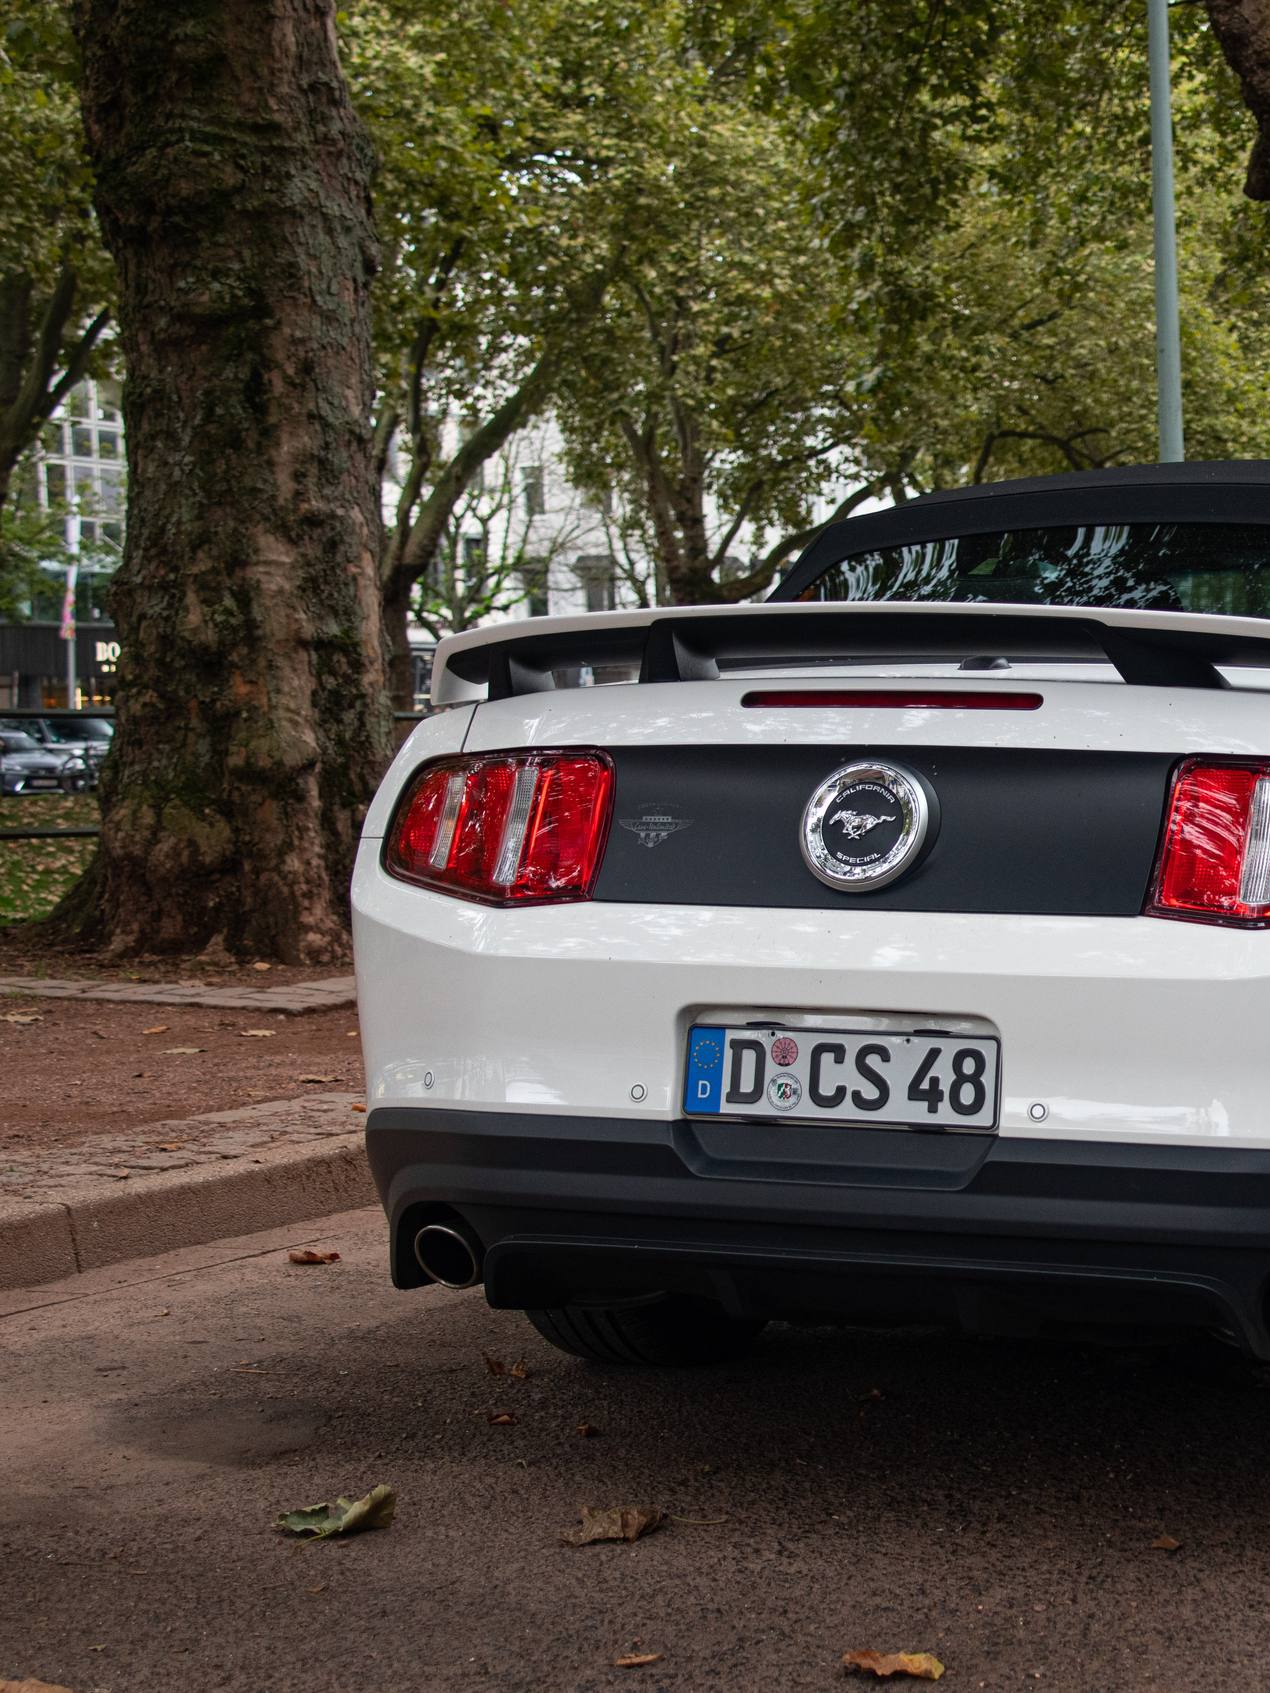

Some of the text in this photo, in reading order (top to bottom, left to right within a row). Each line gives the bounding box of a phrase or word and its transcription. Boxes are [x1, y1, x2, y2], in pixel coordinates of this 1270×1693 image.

[835, 784, 896, 804] CALIFORNIA
[835, 851, 881, 864] SPECIAL
[697, 1080, 711, 1099] D
[726, 1038, 767, 1104] D
[808, 1042, 891, 1111] CS
[907, 1047, 987, 1116] 48
